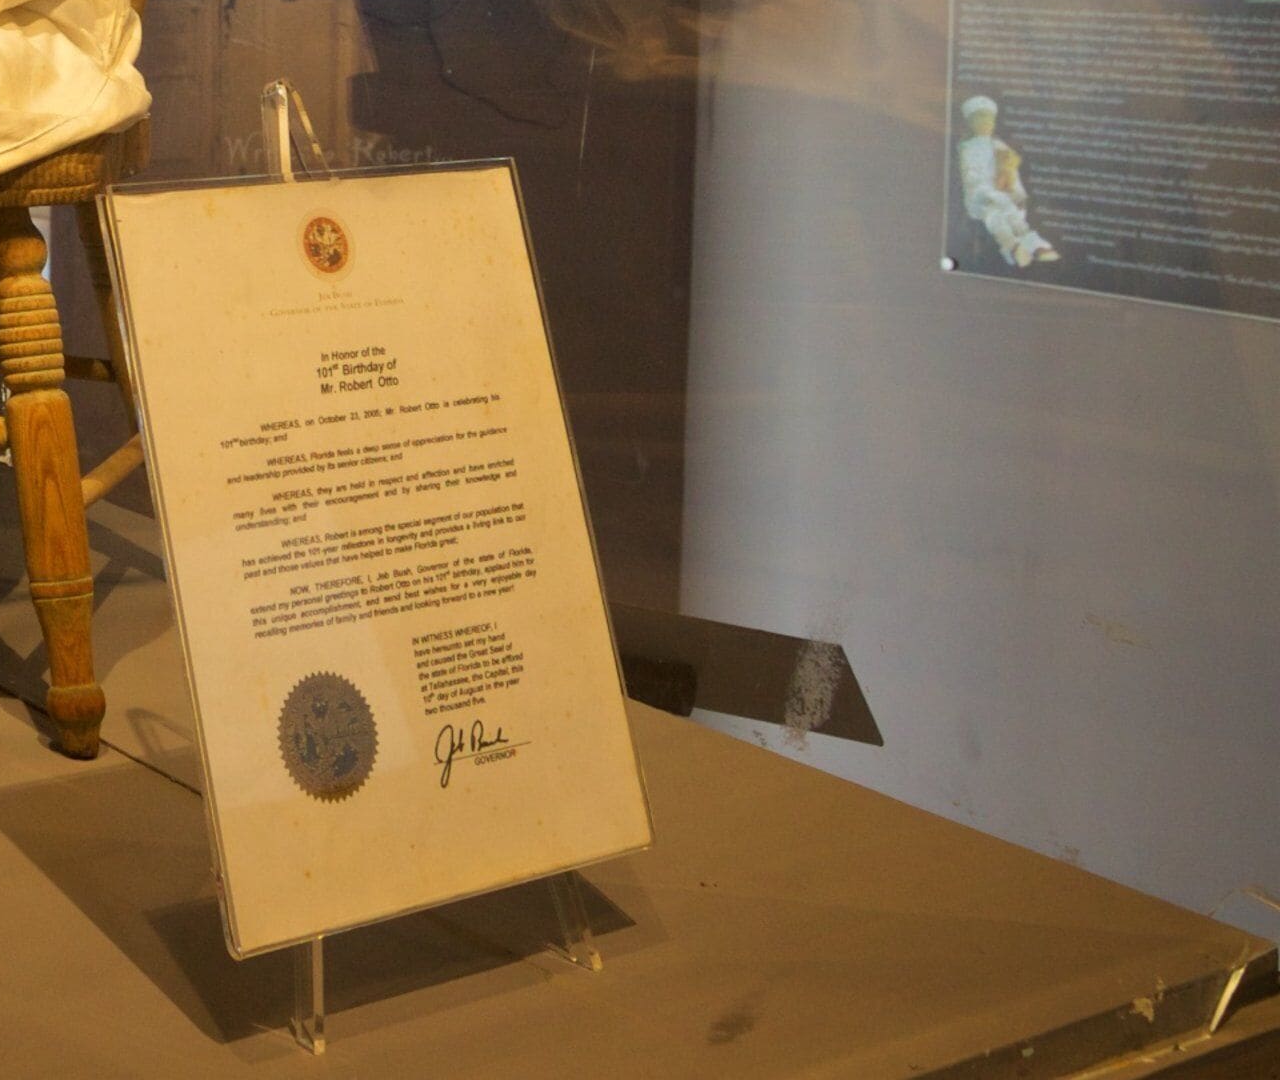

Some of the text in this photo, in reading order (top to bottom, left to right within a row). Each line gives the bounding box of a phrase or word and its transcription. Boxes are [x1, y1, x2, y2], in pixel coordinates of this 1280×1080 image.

[320, 346, 386, 362] In Honor of the
[342, 362, 384, 376] Birthday
[386, 358, 397, 370] of
[320, 374, 399, 394] Mr. Robert Otto
[474, 748, 518, 766] GOVERNOR
